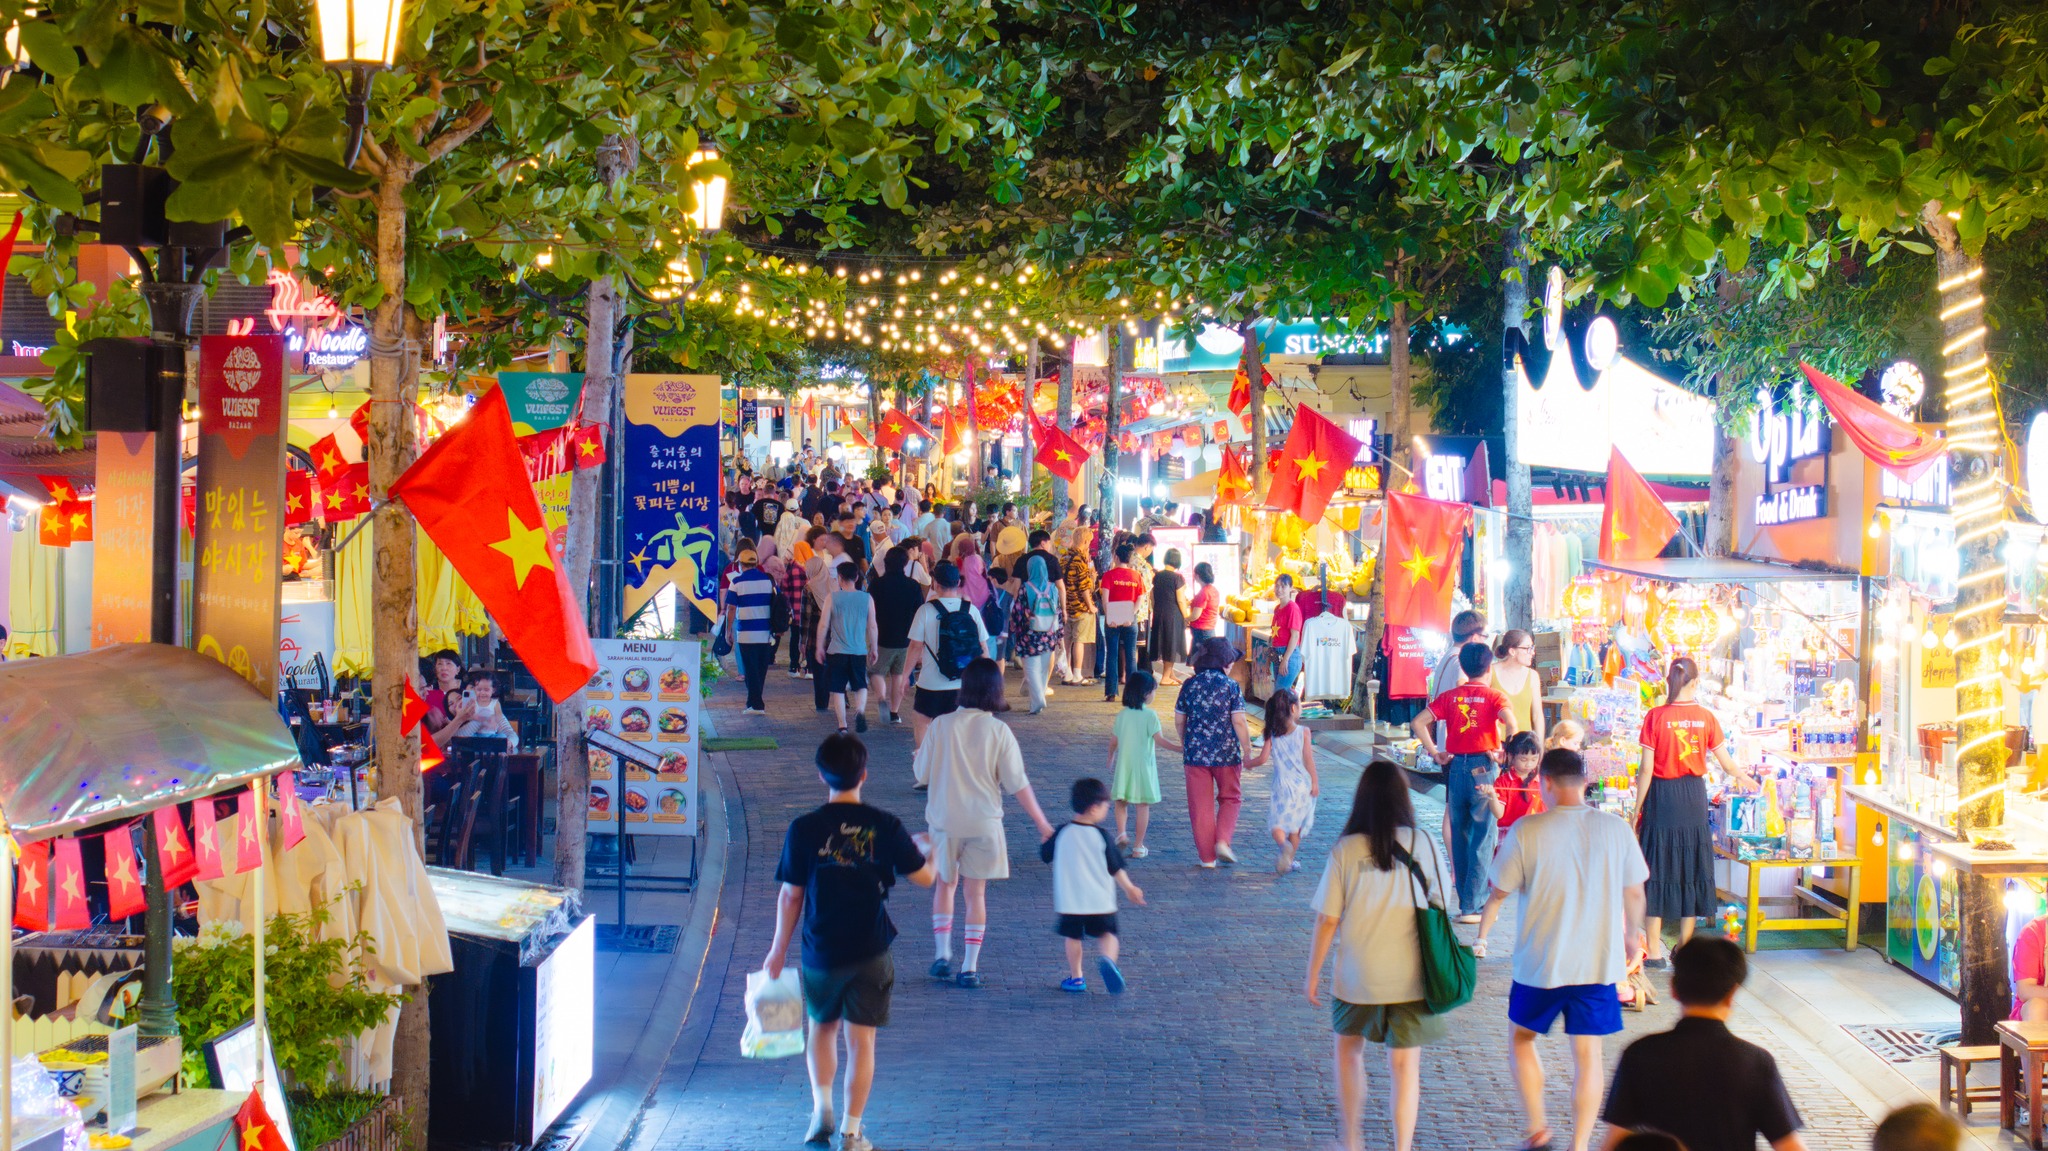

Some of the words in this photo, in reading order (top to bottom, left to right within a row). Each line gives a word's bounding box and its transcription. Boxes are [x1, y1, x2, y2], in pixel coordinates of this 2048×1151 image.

[304, 327, 367, 351] Noodle
[525, 403, 569, 415] VUIFEST
[652, 405, 697, 417] VUIFEST
[649, 444, 702, 458] 즐거움의
[650, 459, 693, 473] 야시장
[652, 479, 696, 494] 기쁨이
[205, 486, 268, 533] 맛있는
[633, 495, 677, 511] 꽃피는
[680, 496, 711, 512] 시장
[1754, 493, 1779, 525] Food
[1779, 490, 1789, 522] &
[1789, 485, 1818, 519] Drink
[201, 539, 269, 585] 야시장
[622, 642, 657, 653] MENU
[1666, 720, 1672, 729] I
[1691, 720, 1704, 728] NAM
